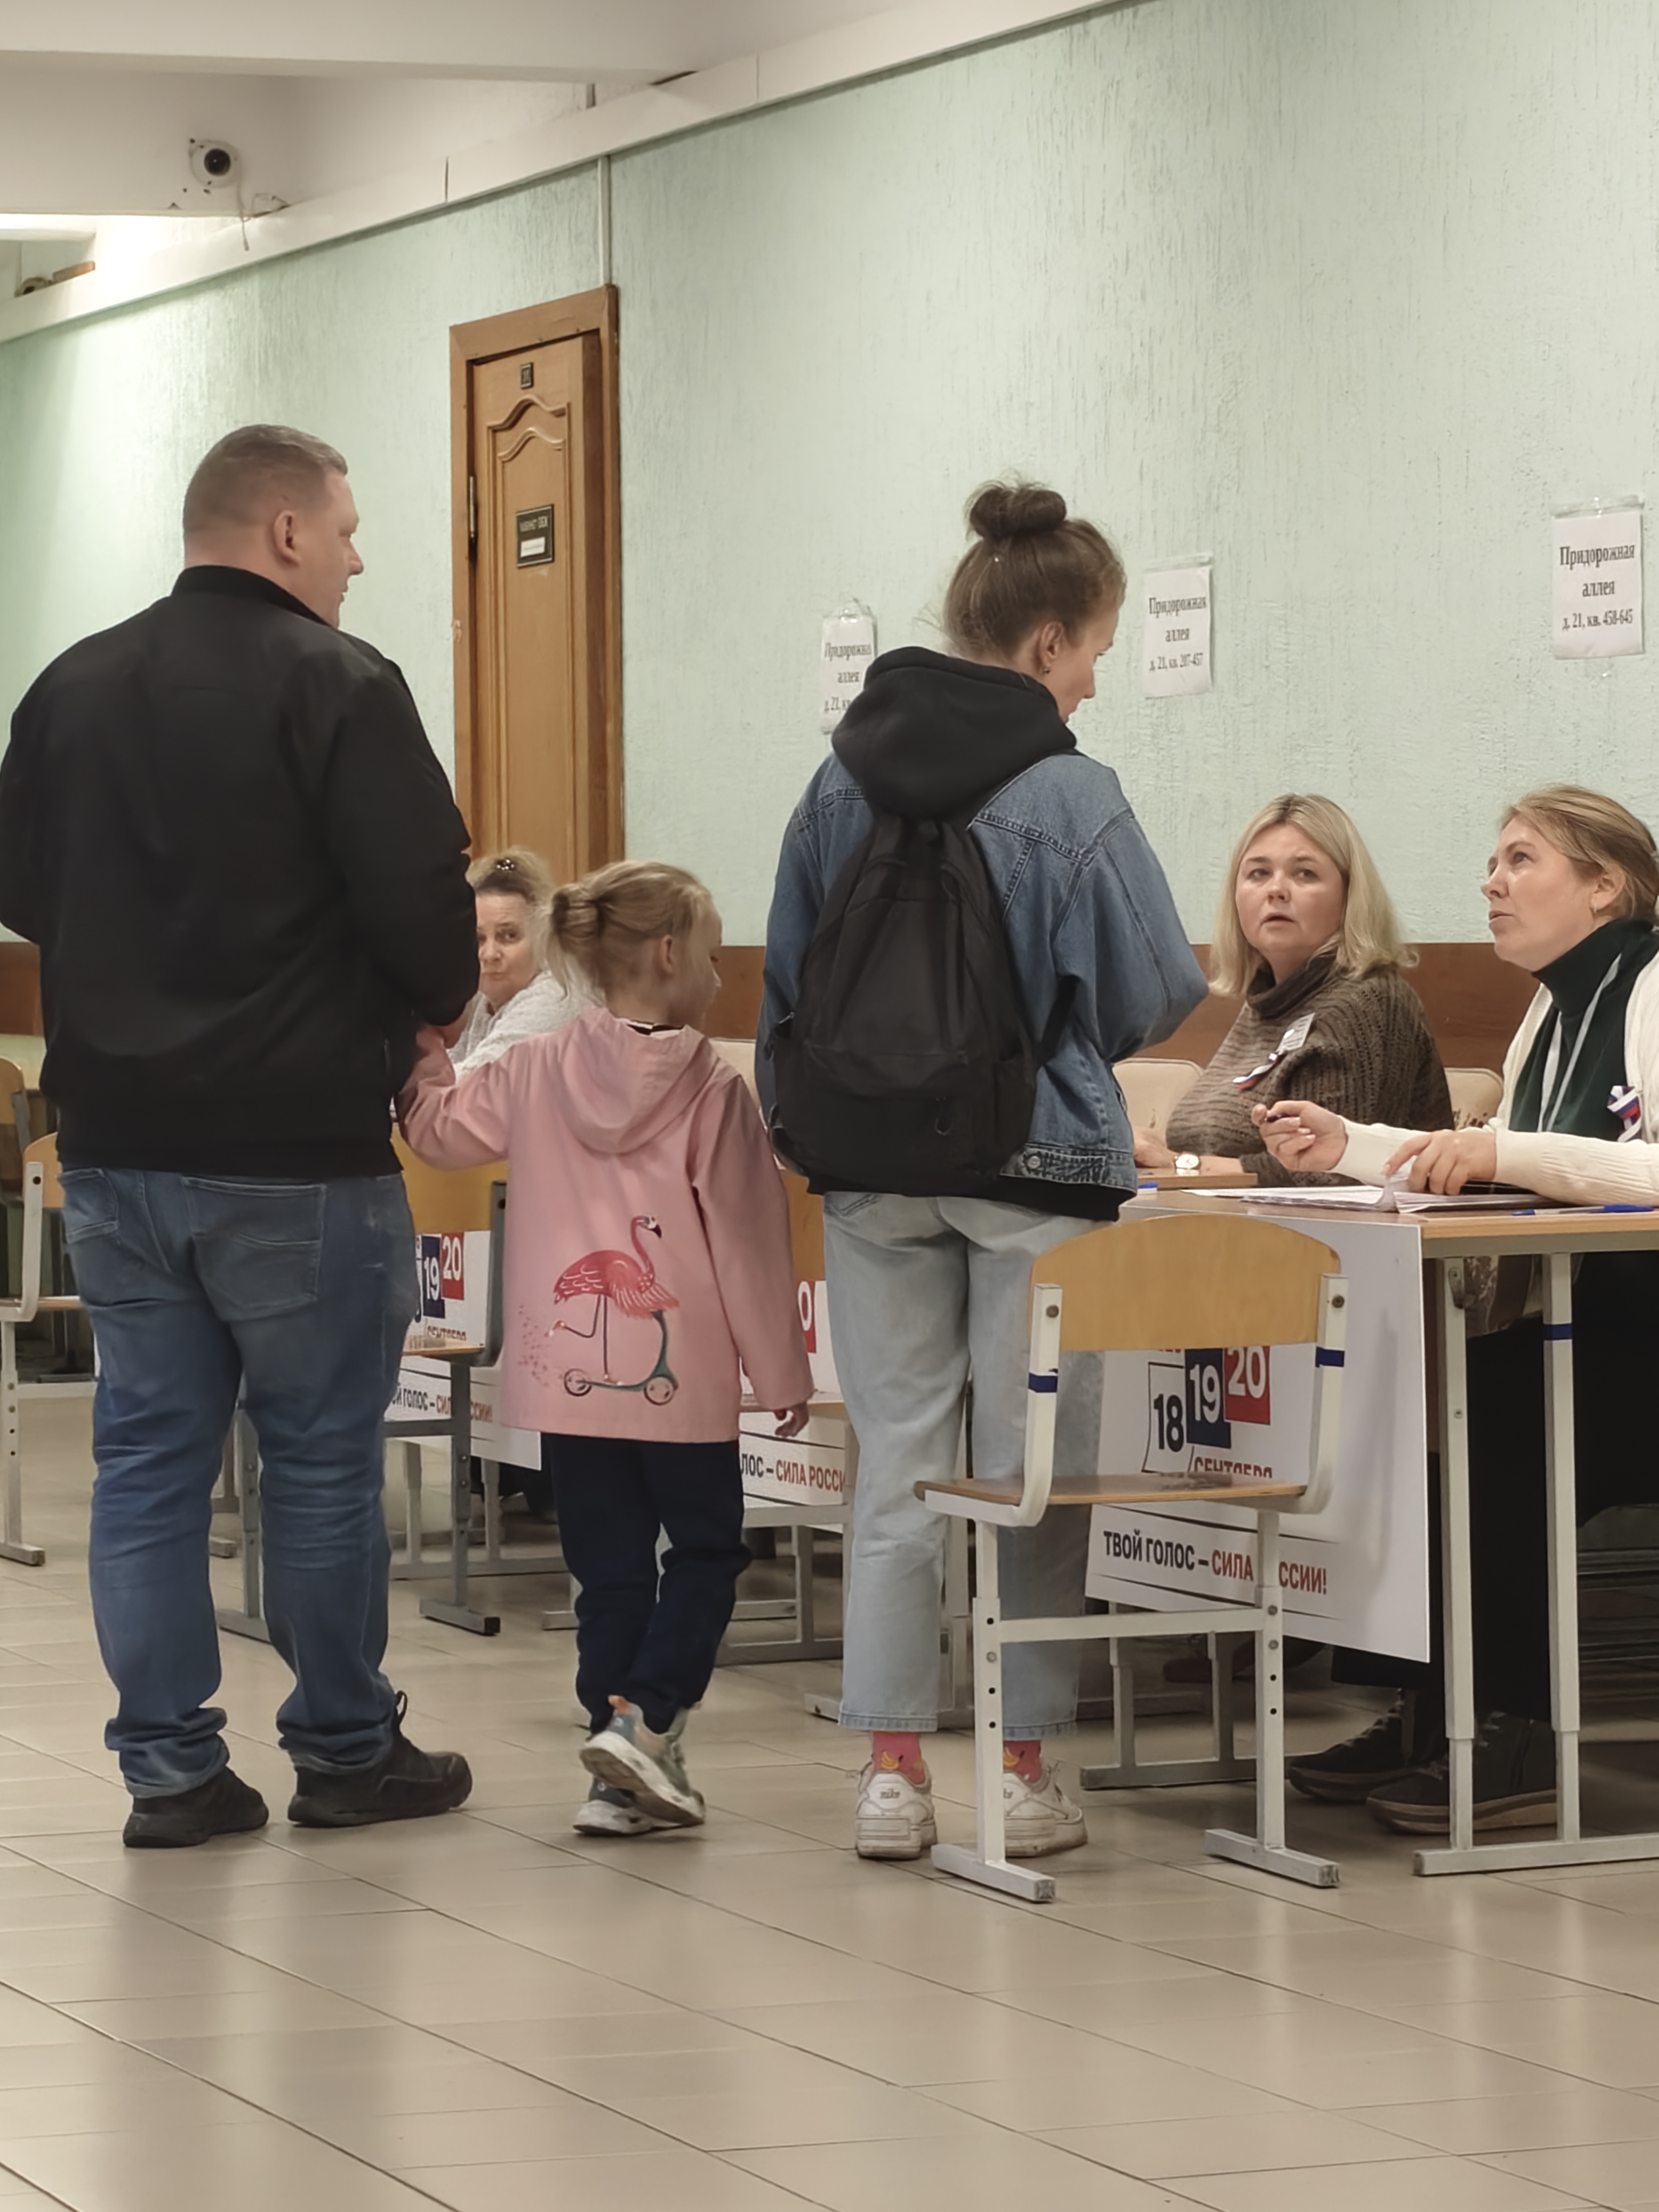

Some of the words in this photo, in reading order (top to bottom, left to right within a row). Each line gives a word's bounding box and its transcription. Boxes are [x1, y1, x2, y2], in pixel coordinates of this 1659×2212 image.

[1560, 545, 1635, 570] Придорожная
[1582, 581, 1615, 597] аллея
[1149, 597, 1206, 618] Придорожная
[1562, 618, 1570, 631] д.
[1587, 616, 1601, 627] кв.
[1603, 609, 1633, 626] 458-645
[1165, 628, 1190, 642] аллея
[424, 1256, 440, 1300] 19
[442, 1236, 462, 1281] 20
[797, 1281, 812, 1331] 0
[403, 1388, 428, 1411] ГОЛОС
[436, 1394, 451, 1415] СИЛ
[1154, 1393, 1184, 1453] 18
[1189, 1364, 1222, 1424] 19
[1228, 1345, 1267, 1399] 20
[740, 1453, 764, 1478] ЛОС
[776, 1459, 807, 1486] СИЛА
[1103, 1529, 1142, 1562] ТВОЙ
[1145, 1540, 1195, 1570] ГОЛОС
[1211, 1550, 1254, 1582] СИЛА
[1278, 1561, 1327, 1595] ССИИ!
